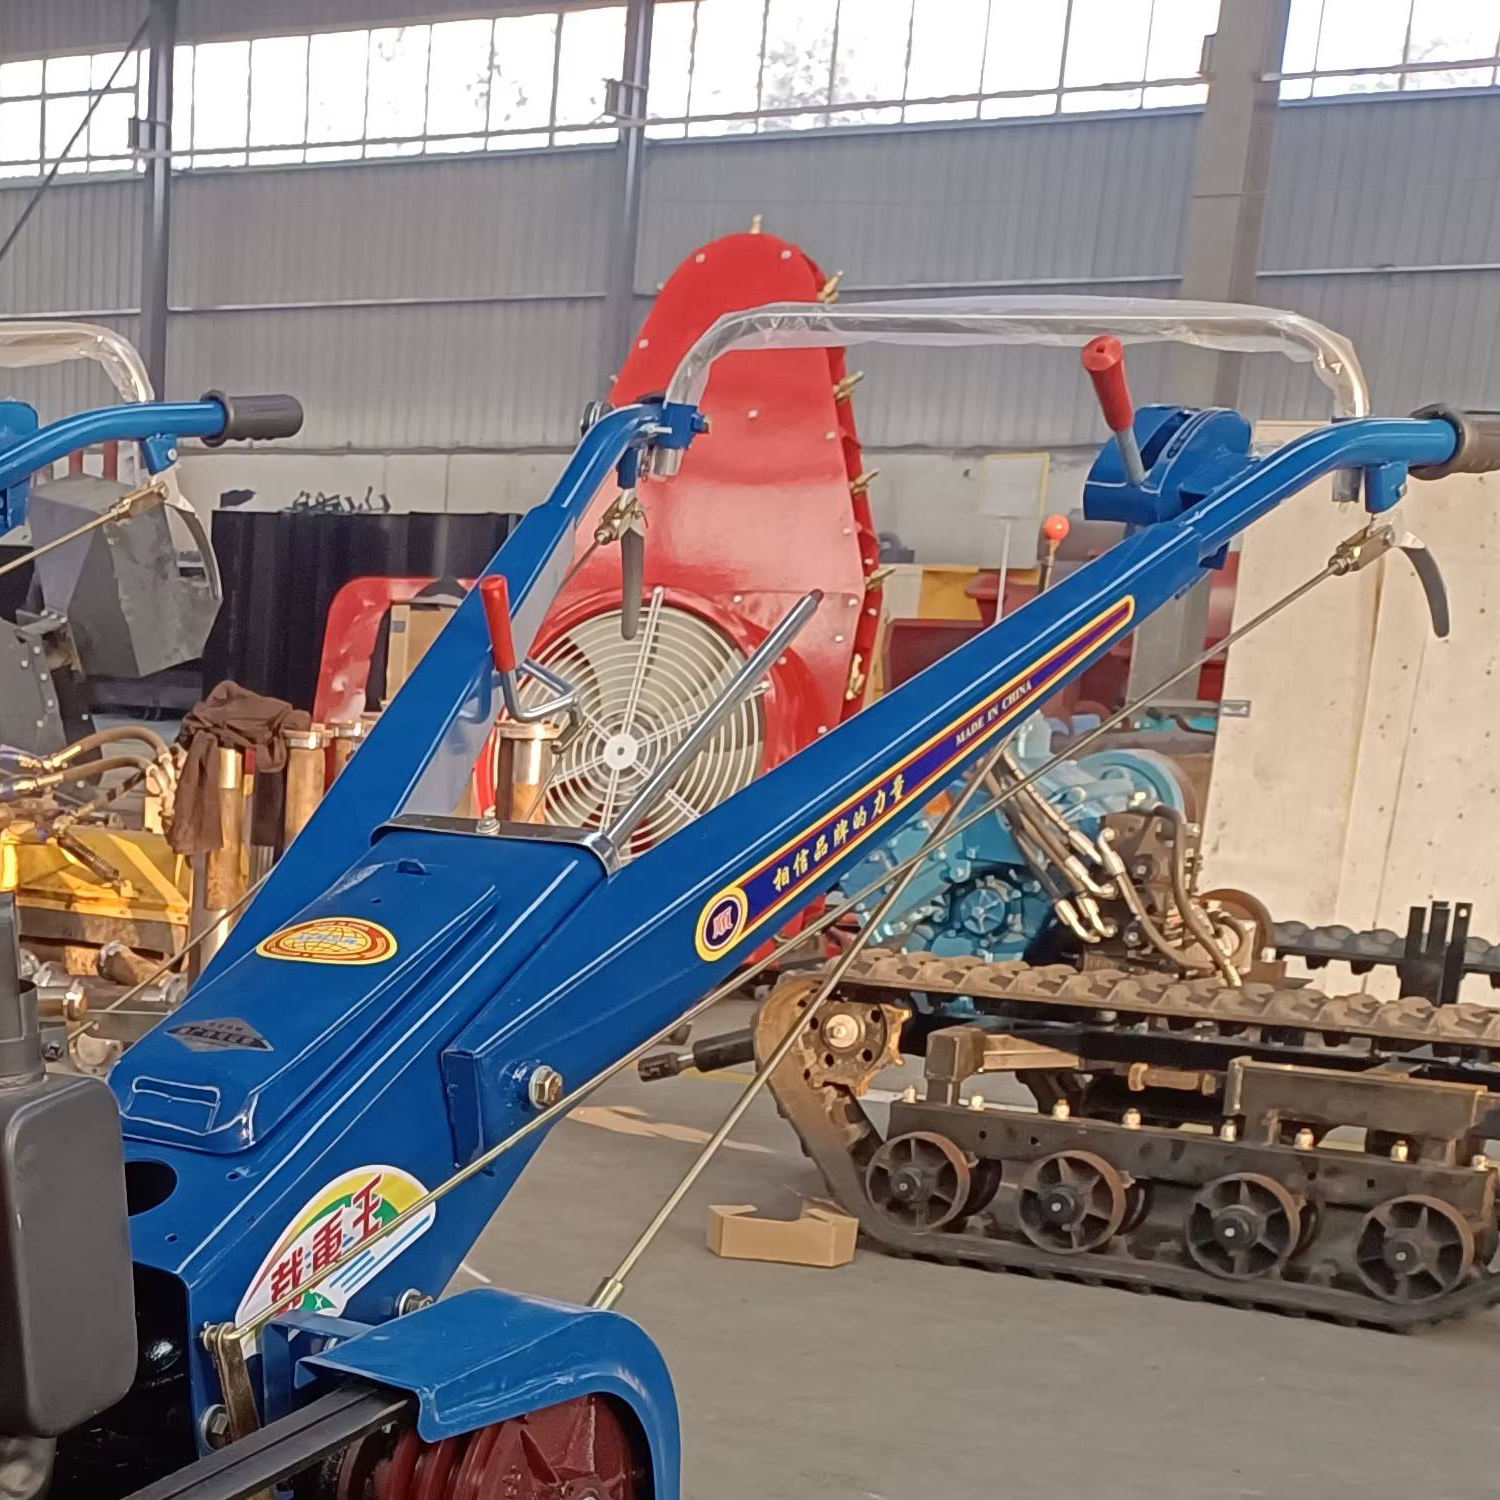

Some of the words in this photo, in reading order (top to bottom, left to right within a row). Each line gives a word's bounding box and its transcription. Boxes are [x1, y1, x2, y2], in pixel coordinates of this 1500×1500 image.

[955, 716, 985, 747] MADE
[986, 704, 1000, 723] IN
[1001, 679, 1033, 711] CHINA
[772, 773, 906, 893] 相信品牌的力量
